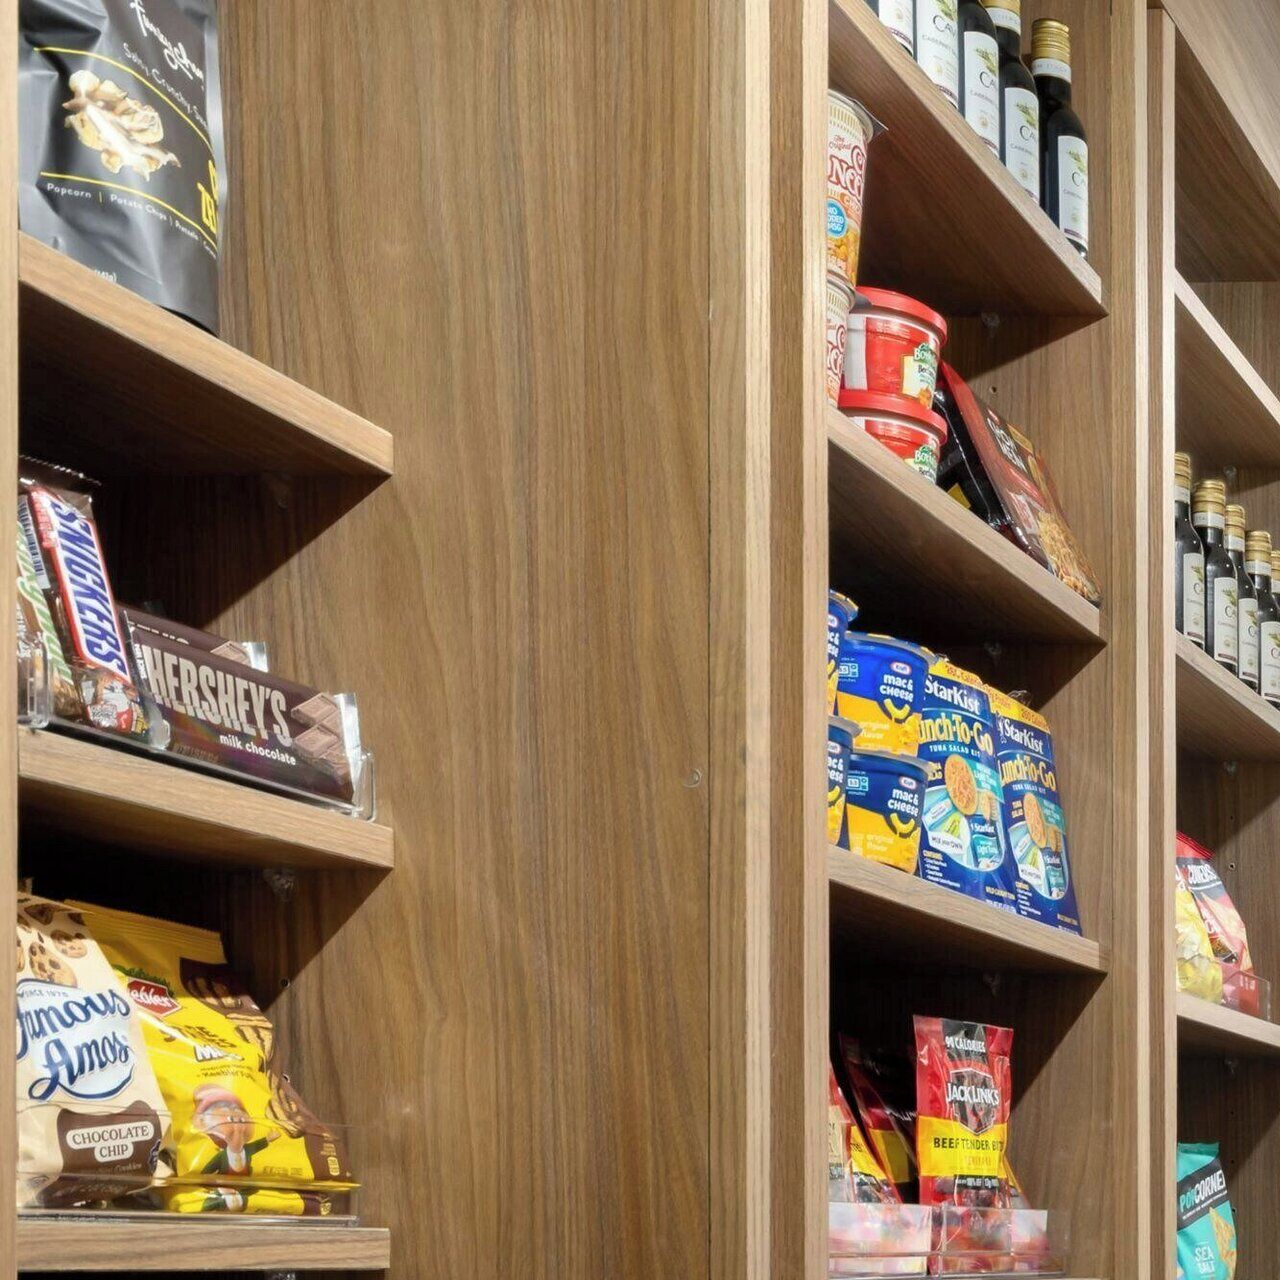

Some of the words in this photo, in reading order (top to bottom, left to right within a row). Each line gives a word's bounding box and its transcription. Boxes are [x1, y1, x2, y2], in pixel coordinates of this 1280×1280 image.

[46, 182, 92, 200] Popcorn
[49, 499, 130, 680] SNICKERS
[883, 673, 906, 690] mac
[142, 643, 294, 749] HERSHEY'S
[924, 673, 981, 715] StarKist
[918, 712, 994, 756] unch-To-Go
[1004, 719, 1044, 755] StarKist
[219, 732, 243, 752] milk
[245, 739, 297, 767] chocolate
[891, 787, 912, 804] mac
[29, 1031, 131, 1099] Amos
[946, 1083, 972, 1104] JACK
[71, 1124, 150, 1146] CHOCOLATE
[933, 1137, 959, 1150] BEEF
[962, 1138, 990, 1151] TENDER
[99, 1143, 129, 1159] CHIP
[1195, 1245, 1215, 1261] SEA
